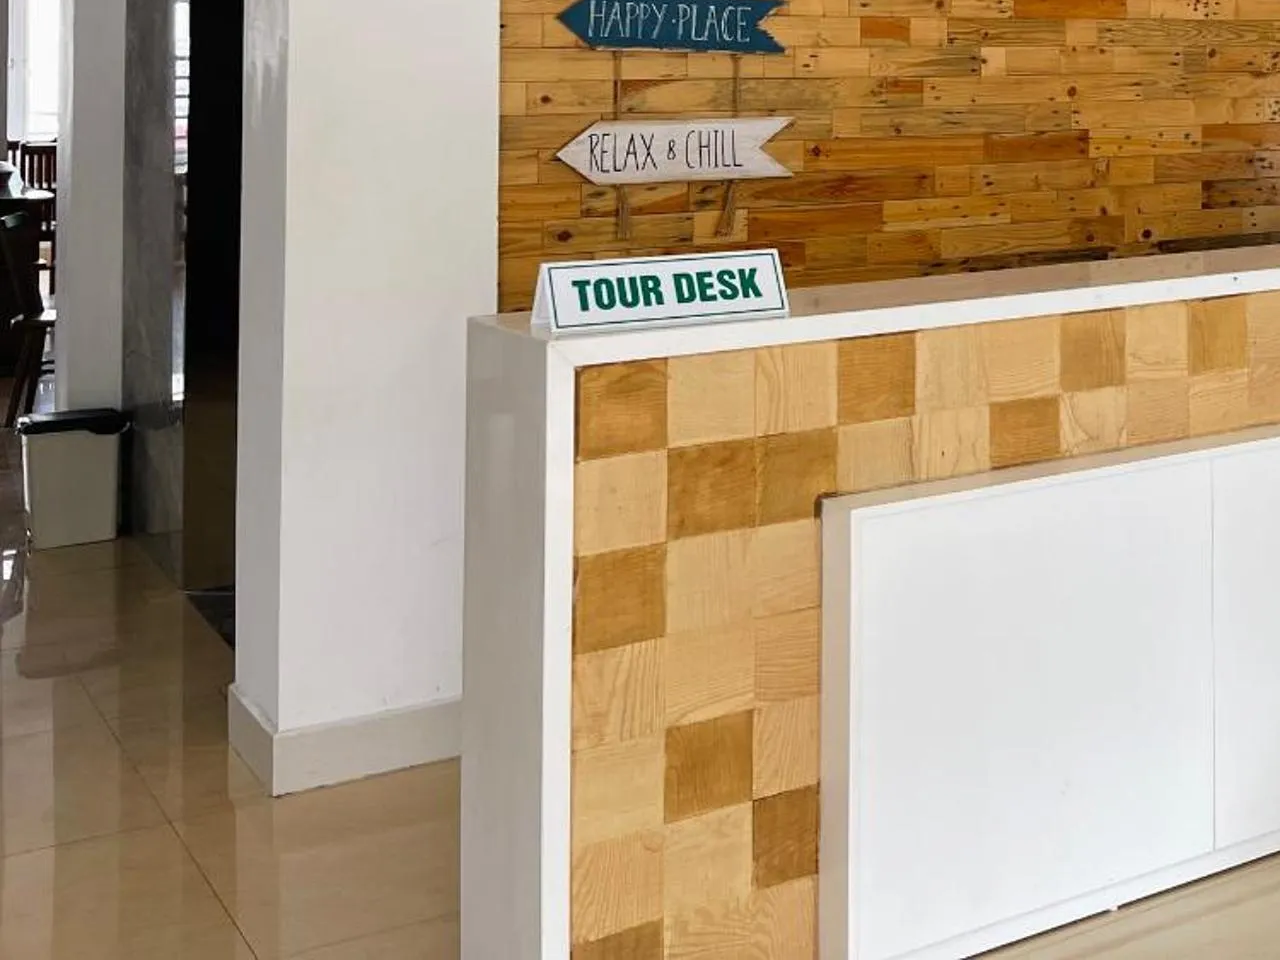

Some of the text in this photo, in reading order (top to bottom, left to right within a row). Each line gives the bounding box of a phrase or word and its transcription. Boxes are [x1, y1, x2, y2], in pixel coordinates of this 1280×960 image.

[588, 0, 752, 43] HAPPY PLACE
[588, 129, 743, 173] RELAX & CHILL
[571, 267, 763, 312] TOUR DESK
